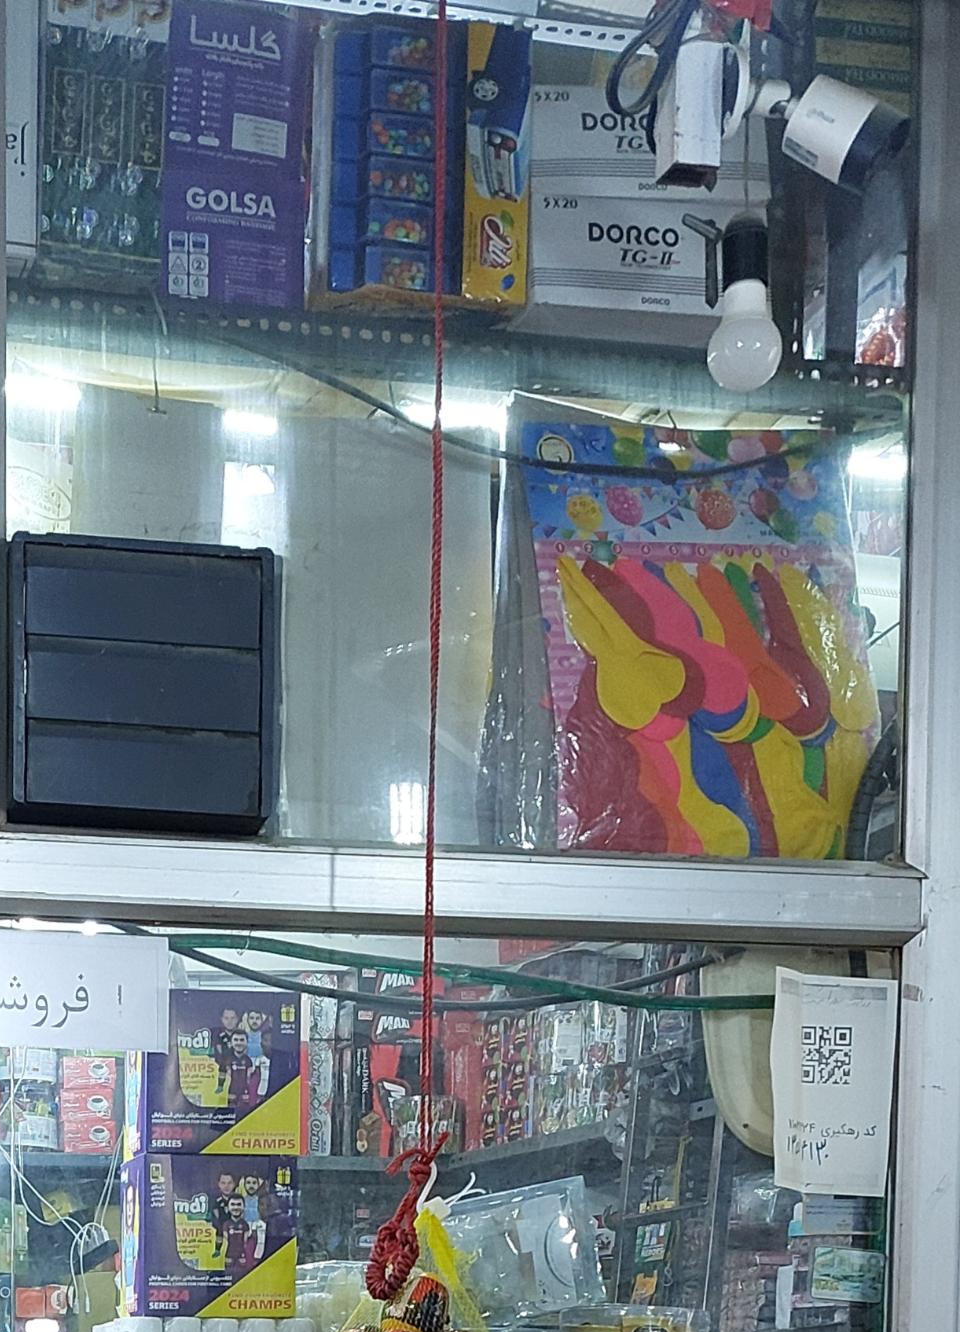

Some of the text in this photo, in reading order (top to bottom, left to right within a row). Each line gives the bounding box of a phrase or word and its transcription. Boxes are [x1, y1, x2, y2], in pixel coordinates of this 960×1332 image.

[189, 14, 282, 62] گلسا
[186, 186, 277, 219] GOLSA
[587, 222, 680, 247] DORCO
[641, 297, 670, 306] DORCO
[379, 972, 415, 993] MAXI
[376, 1014, 411, 1036] MAXI
[151, 1139, 182, 1148] SERIES
[231, 1138, 296, 1150] CHAMPS
[148, 1301, 180, 1310] SERIES
[228, 1298, 293, 1311] CHAMPS
